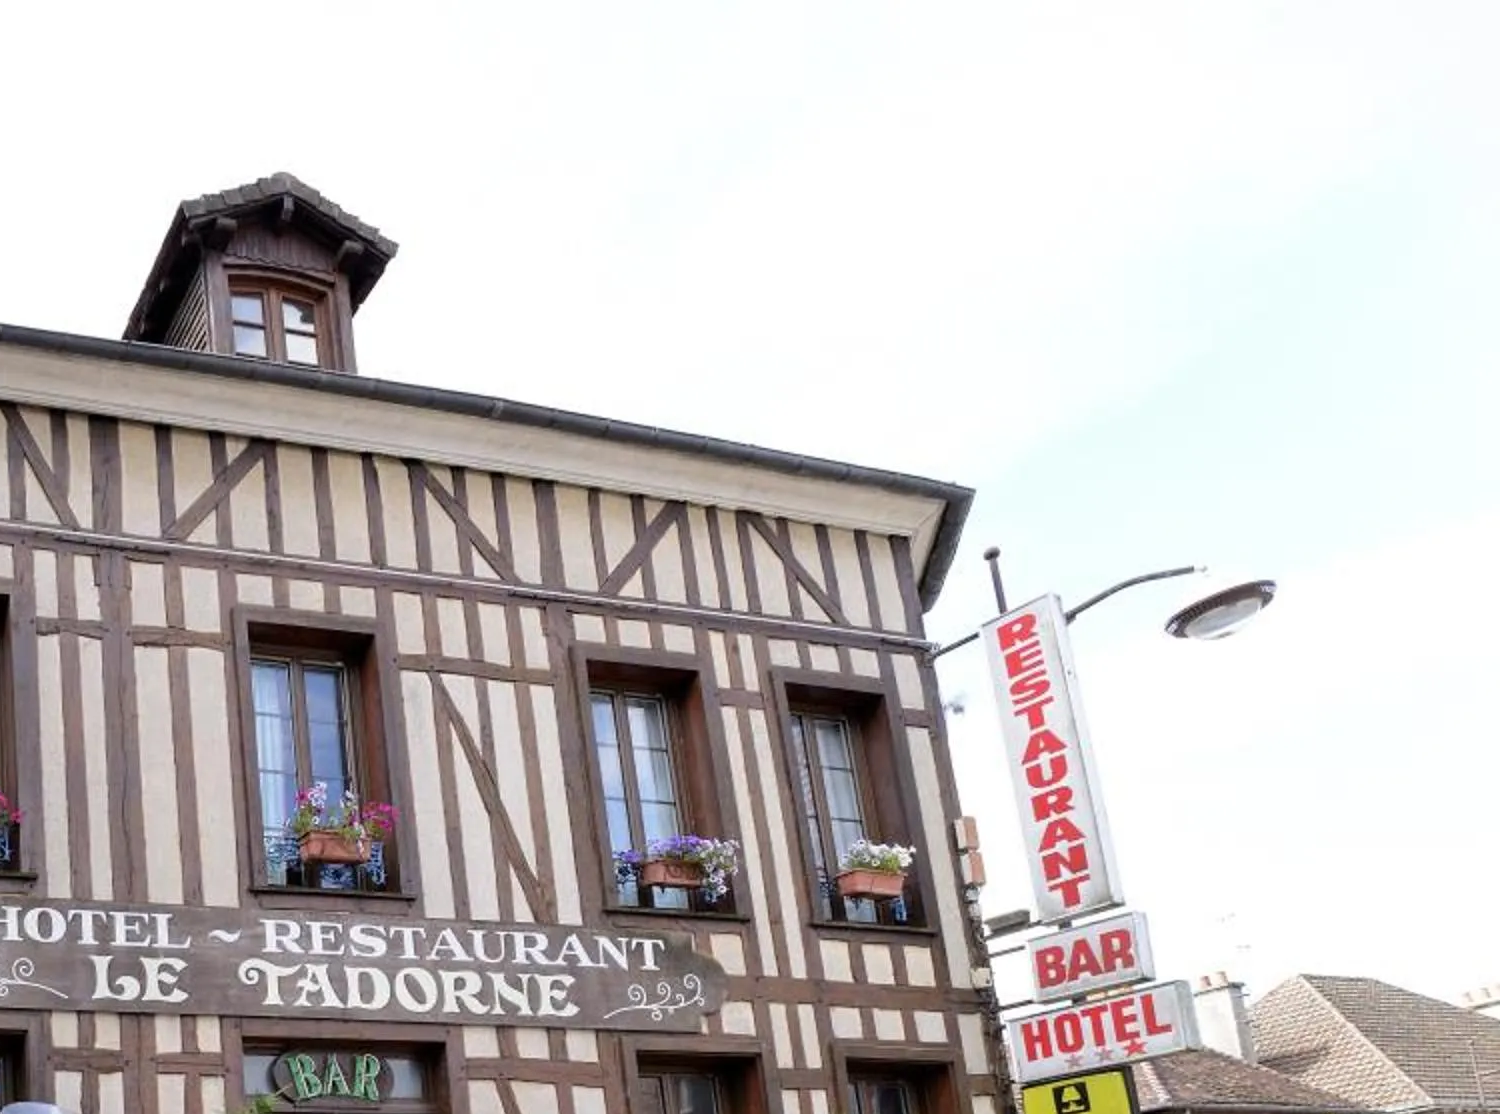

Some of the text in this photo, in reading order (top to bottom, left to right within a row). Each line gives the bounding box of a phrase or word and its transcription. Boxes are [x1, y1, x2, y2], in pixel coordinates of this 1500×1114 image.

[996, 613, 1091, 908] RESTAURANT
[259, 918, 665, 972] RESTAURANT
[1034, 928, 1135, 989] BAR
[88, 955, 581, 1018] LE TADORNE
[1021, 993, 1173, 1063] HOTEL
[285, 1052, 382, 1102] BAR
